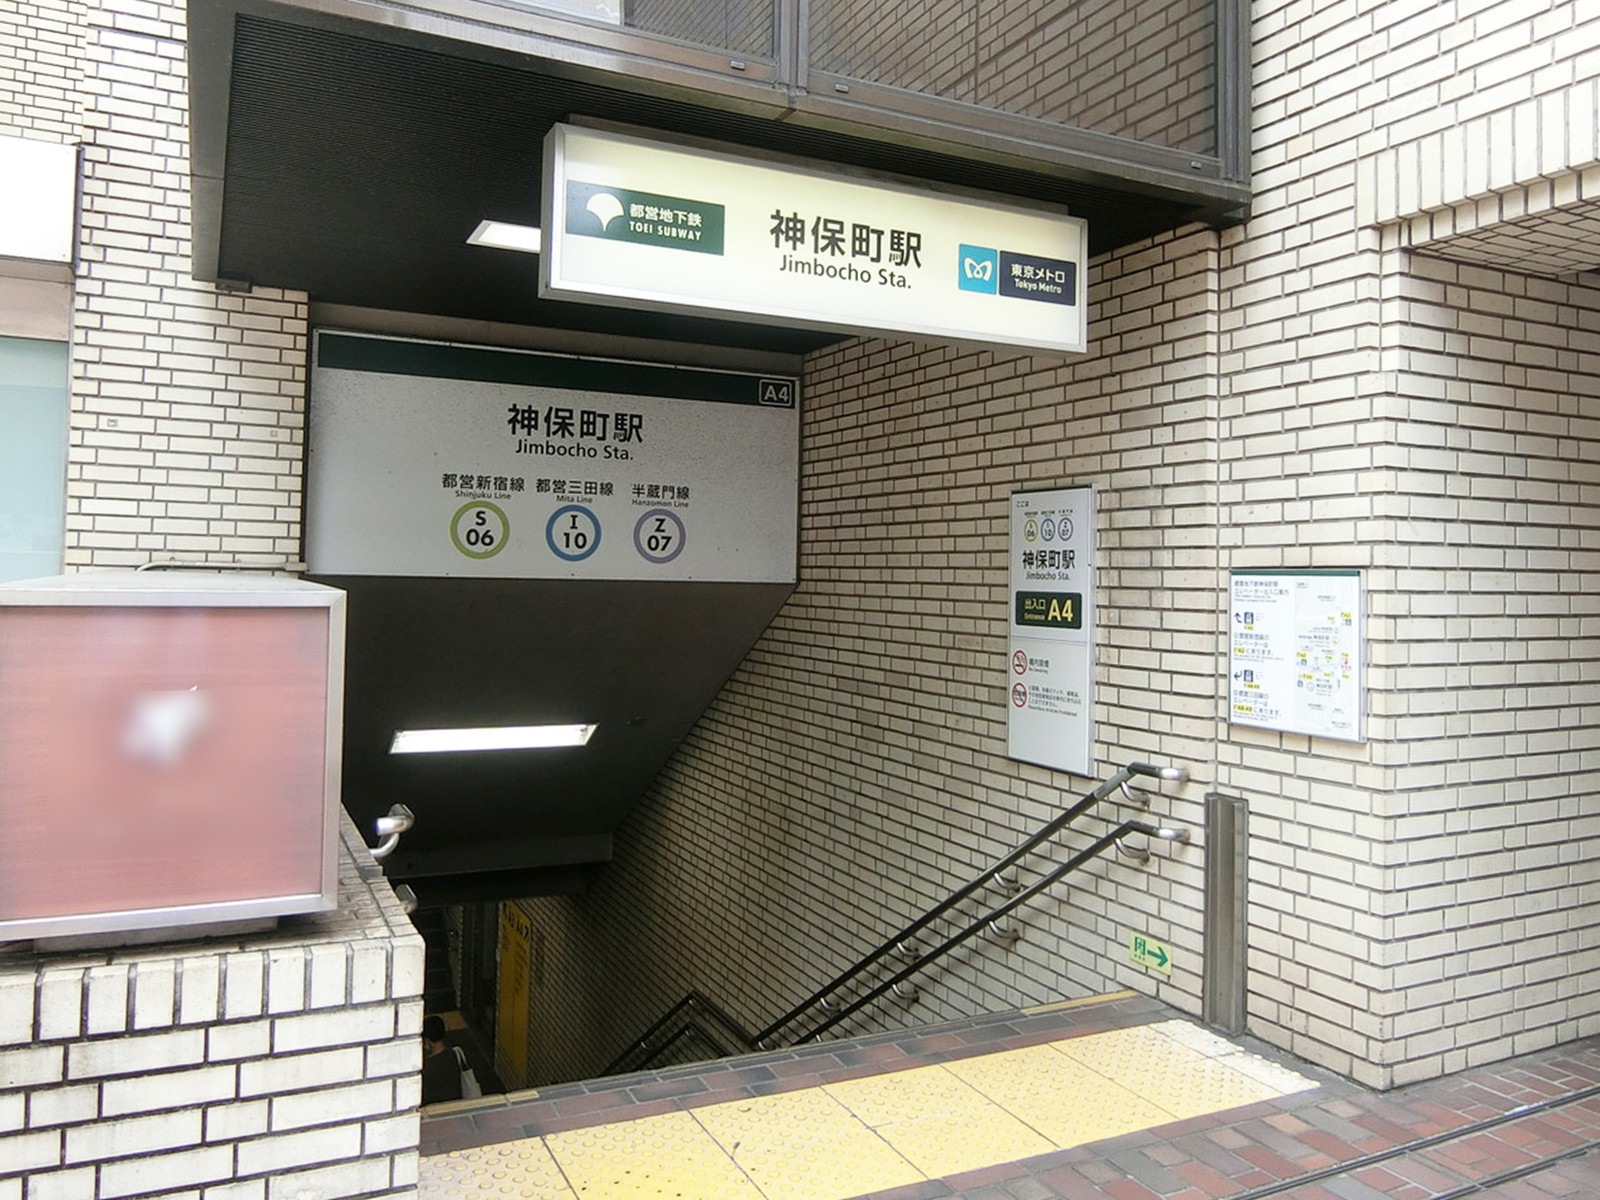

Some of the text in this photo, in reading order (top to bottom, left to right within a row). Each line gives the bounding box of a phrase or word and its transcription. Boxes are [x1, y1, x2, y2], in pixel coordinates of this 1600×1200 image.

[629, 203, 702, 228] 都営地下鉄
[629, 221, 702, 241] TOEI SUBWAY
[769, 209, 922, 269] 神保町駅
[779, 254, 912, 289] Jimbocho Sta.
[1010, 263, 1066, 284] 東京メトロ
[1014, 278, 1062, 294] Tokyo Metro
[763, 384, 789, 402] A4
[507, 403, 643, 444] 神保町駅
[515, 439, 634, 461] Jimbocho Sta.
[442, 473, 525, 492] 都営新宿線
[535, 478, 614, 497] 都営三田線
[631, 483, 690, 500] 半蔵門線
[455, 489, 512, 500] Shinjuku Line
[556, 494, 593, 504] Mita Line
[631, 499, 672, 508] Hanzomon
[475, 510, 487, 526] S
[569, 514, 578, 530] I
[654, 518, 667, 533] Z
[466, 528, 495, 547] 06
[563, 532, 587, 549] 10
[647, 535, 673, 551] 07
[1022, 550, 1076, 570] 神保町駅
[1026, 570, 1071, 580] Jimbocho Sta.
[1024, 599, 1046, 610] 出入口
[1047, 598, 1074, 622] A4
